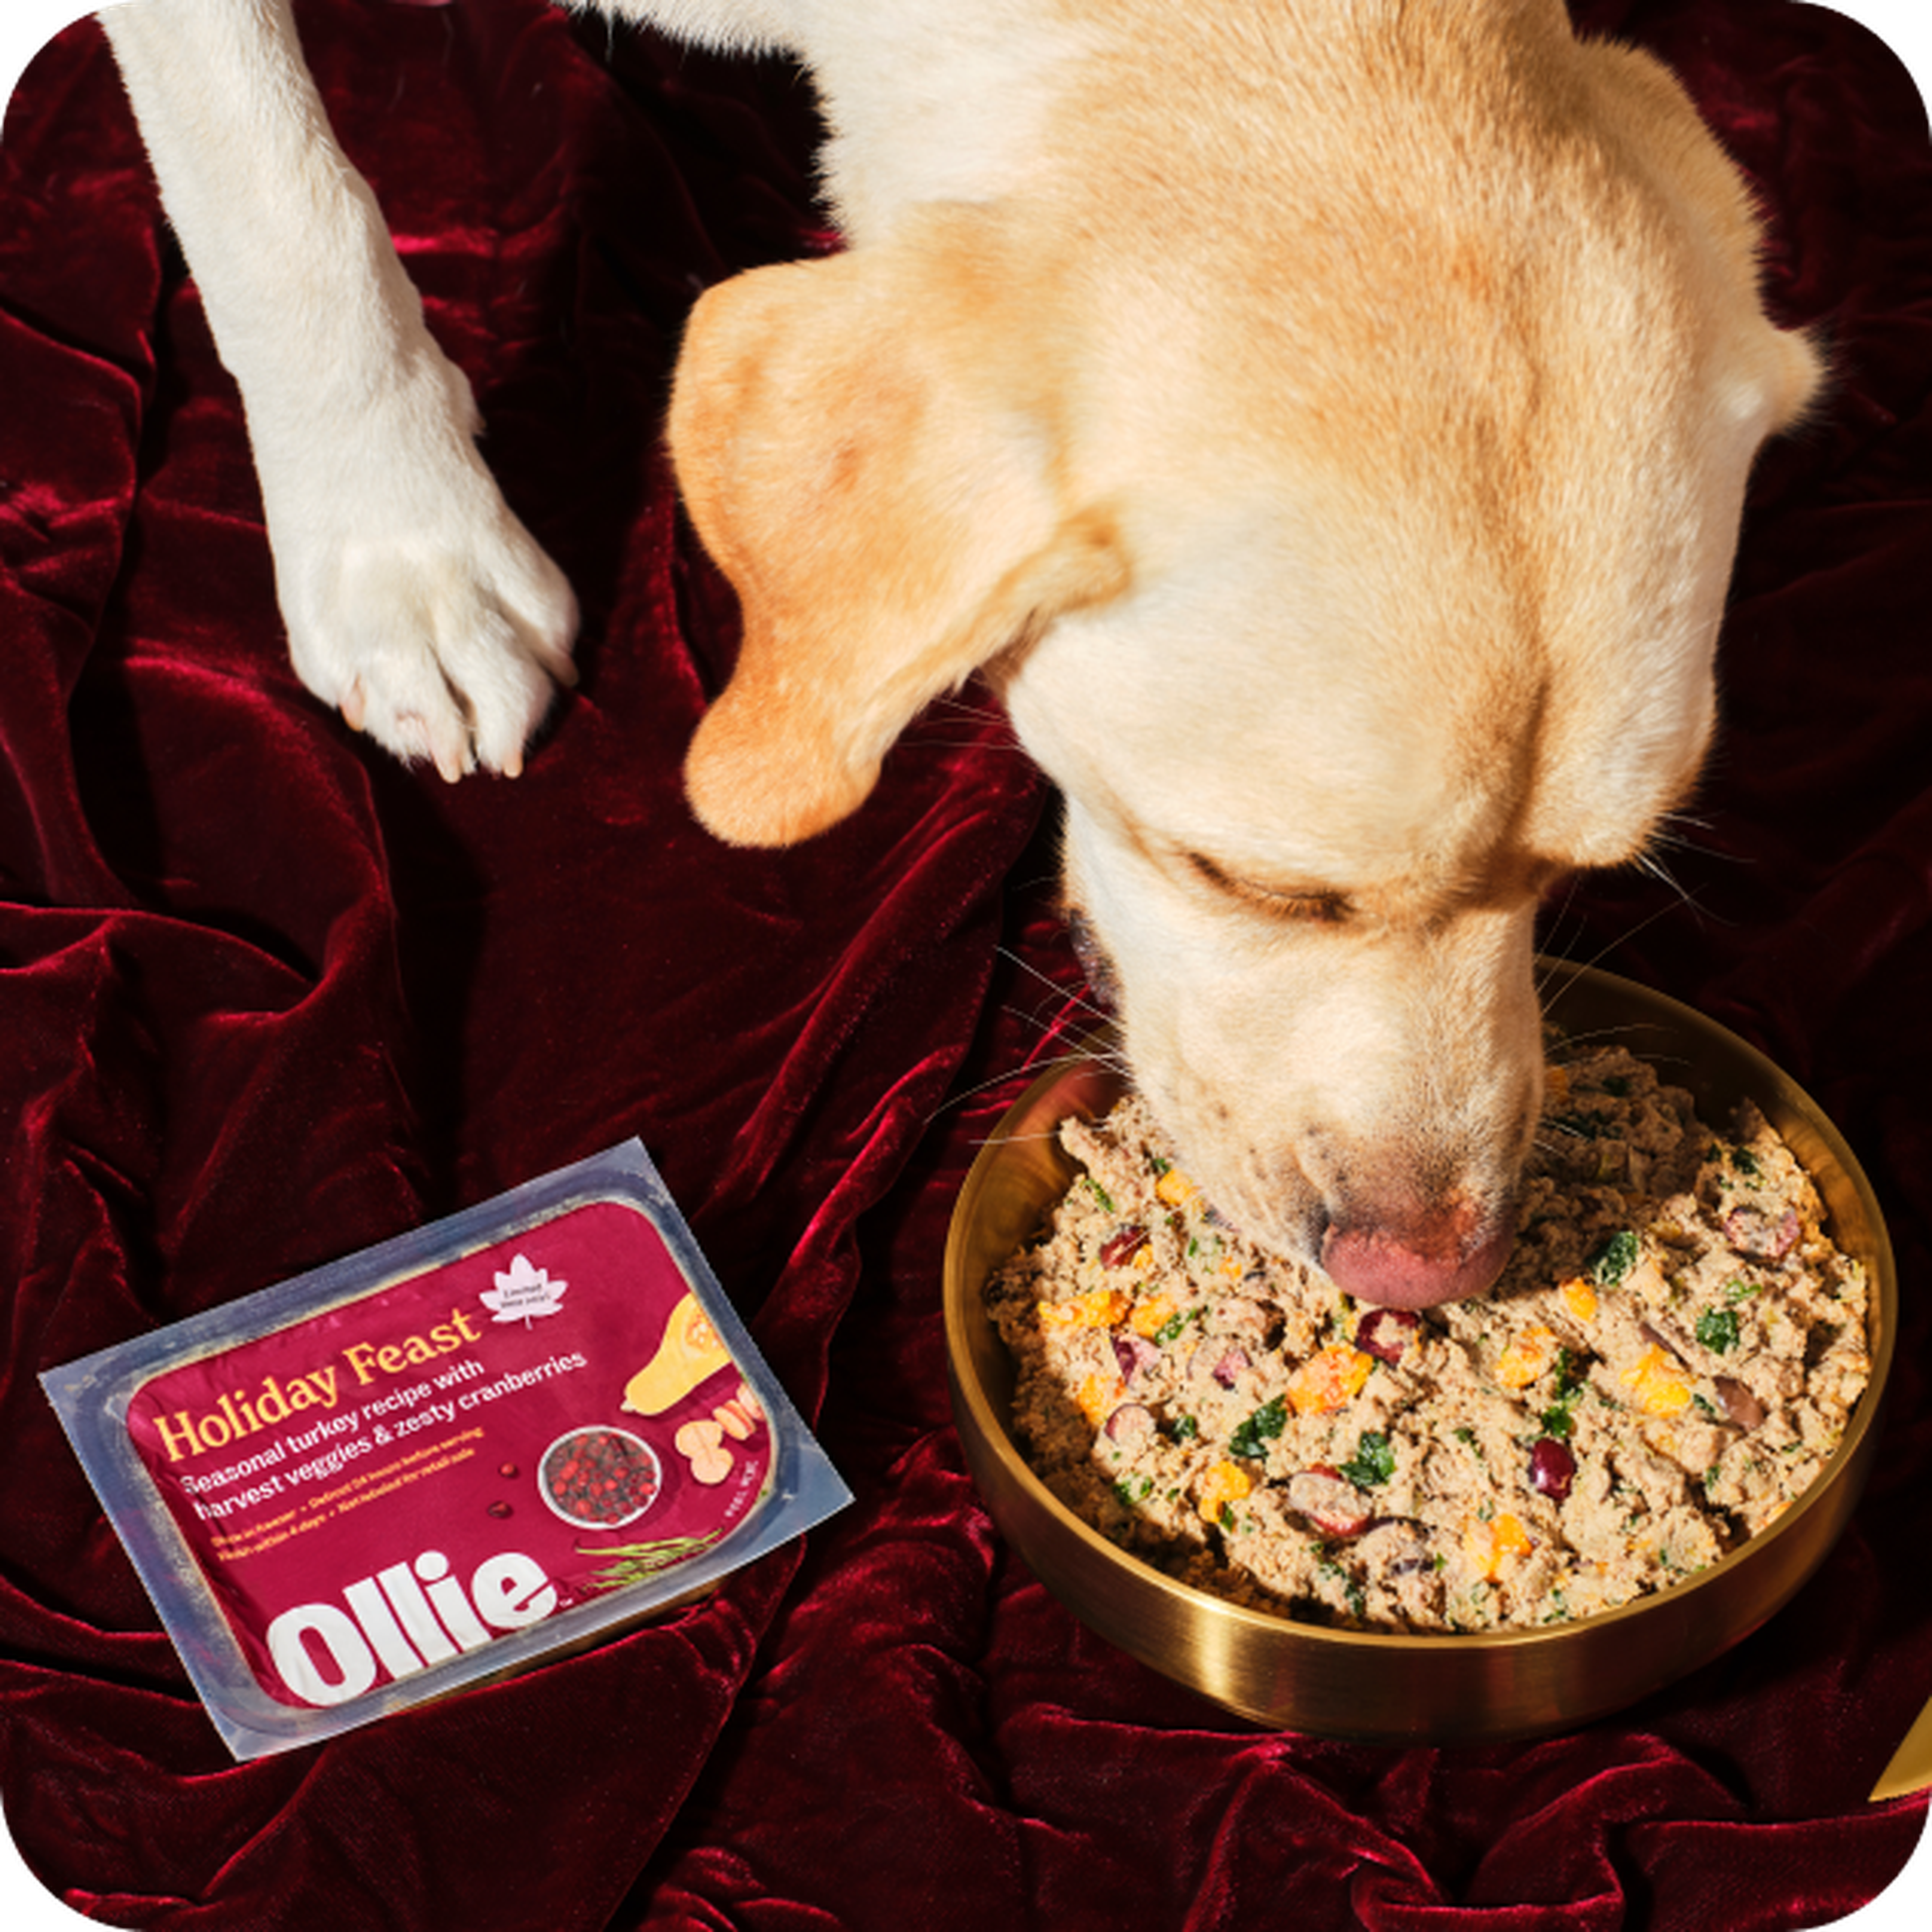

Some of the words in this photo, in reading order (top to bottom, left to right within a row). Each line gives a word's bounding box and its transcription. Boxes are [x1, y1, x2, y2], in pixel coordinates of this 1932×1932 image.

[153, 1366, 338, 1462] Holiday
[343, 1308, 481, 1385] Feast
[180, 1441, 286, 1494] Seasonal
[286, 1411, 359, 1453] turkey
[362, 1382, 432, 1419] recipe
[433, 1359, 485, 1390] with
[193, 1475, 285, 1520] harvest
[285, 1437, 372, 1480] veggies
[373, 1423, 394, 1445] &
[394, 1401, 455, 1437] zesty
[458, 1352, 588, 1410] cranberries
[266, 1550, 557, 1707] Ollie
